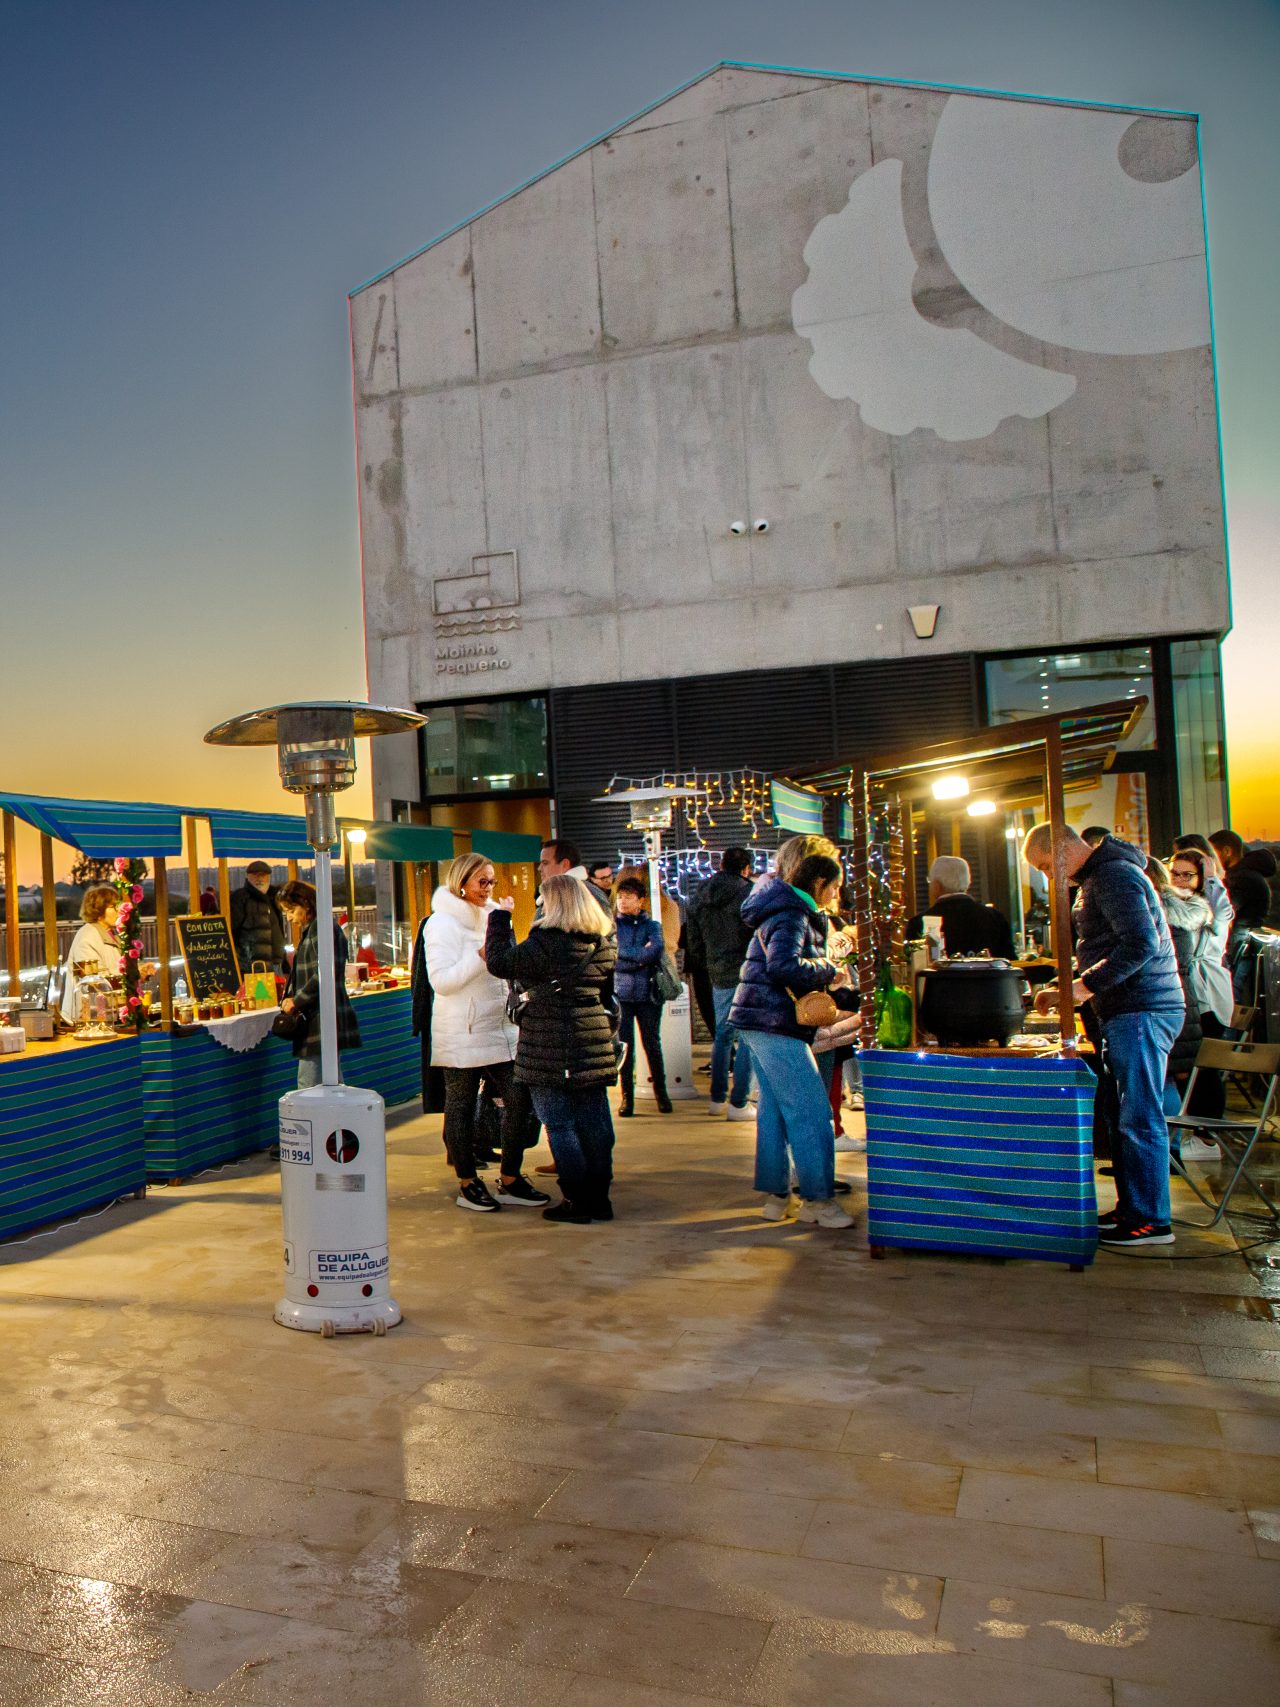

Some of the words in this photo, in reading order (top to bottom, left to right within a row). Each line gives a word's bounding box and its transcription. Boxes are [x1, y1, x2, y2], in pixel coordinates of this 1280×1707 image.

[435, 642, 498, 660] Moinho
[435, 659, 512, 676] Pequeno
[291, 1150, 311, 1162] 994
[317, 1252, 370, 1263] EQUIPA
[318, 1263, 338, 1273] DE
